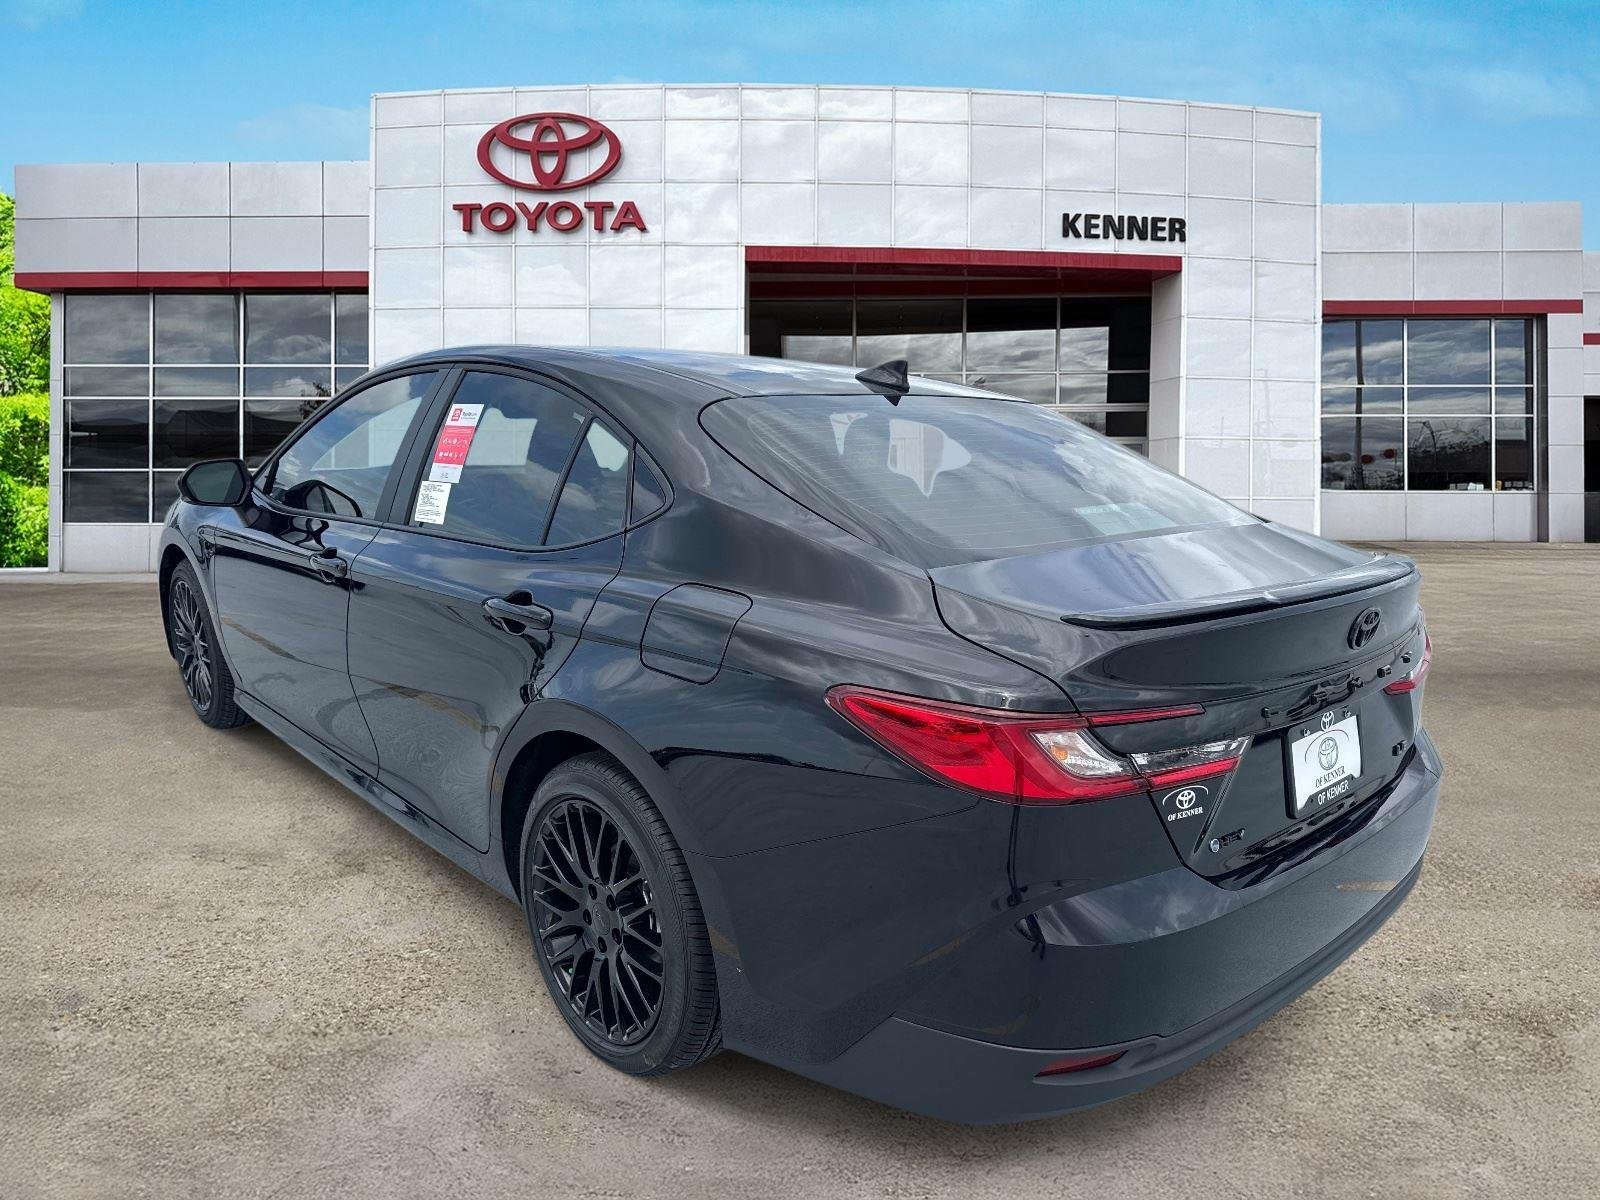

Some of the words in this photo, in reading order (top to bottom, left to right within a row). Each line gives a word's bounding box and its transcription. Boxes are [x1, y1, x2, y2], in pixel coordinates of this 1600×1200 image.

[452, 200, 647, 233] TOYOTA
[1062, 212, 1187, 242] KENNER
[1323, 766, 1345, 784] KENNER
[1317, 792, 1326, 805] OF
[1327, 780, 1349, 800] KENNER
[1167, 813, 1176, 822] OF
[1176, 806, 1203, 820] KENNER
